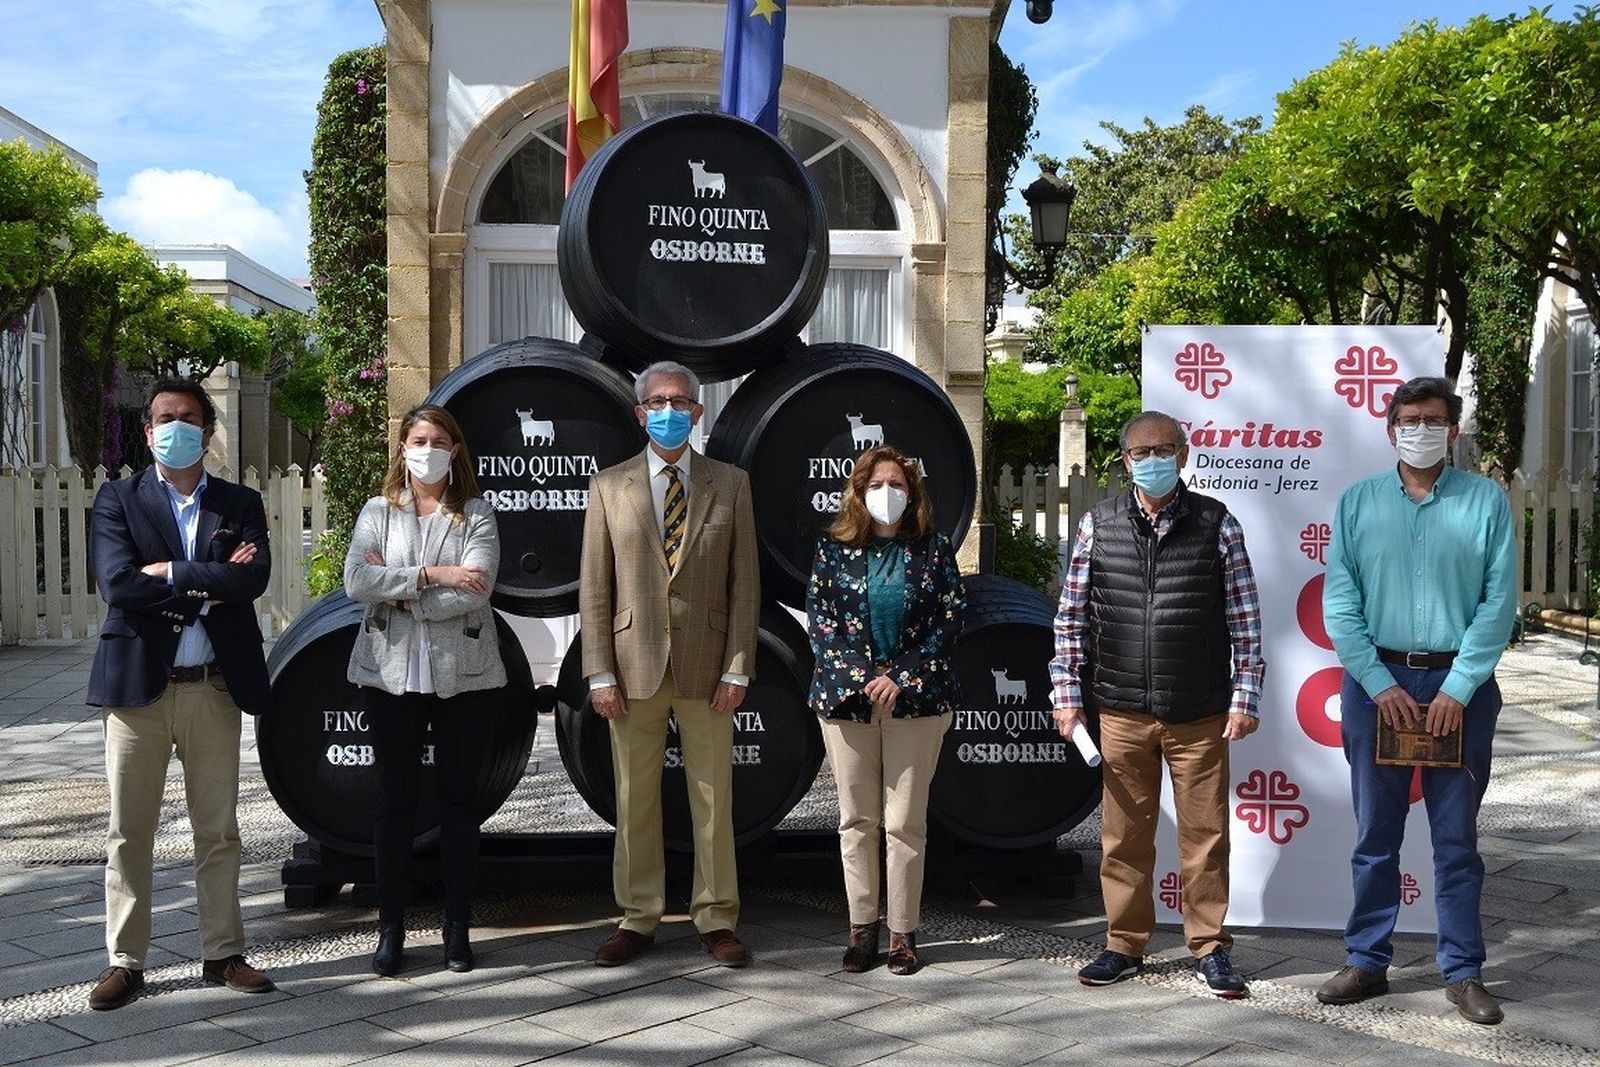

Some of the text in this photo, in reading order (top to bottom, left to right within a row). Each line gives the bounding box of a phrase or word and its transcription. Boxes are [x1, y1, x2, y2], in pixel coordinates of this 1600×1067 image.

[647, 204, 770, 236] FINO QUINTA
[650, 238, 766, 265] OSBORNE
[477, 456, 599, 485] FINO QUINTA
[807, 457, 855, 479] FINO
[1196, 453, 1311, 470] Diocesana de
[1187, 473, 1258, 490] Asidonia
[1275, 475, 1319, 495] Jerez
[954, 710, 1000, 731] FINO
[956, 742, 1067, 764] OSBORNE
